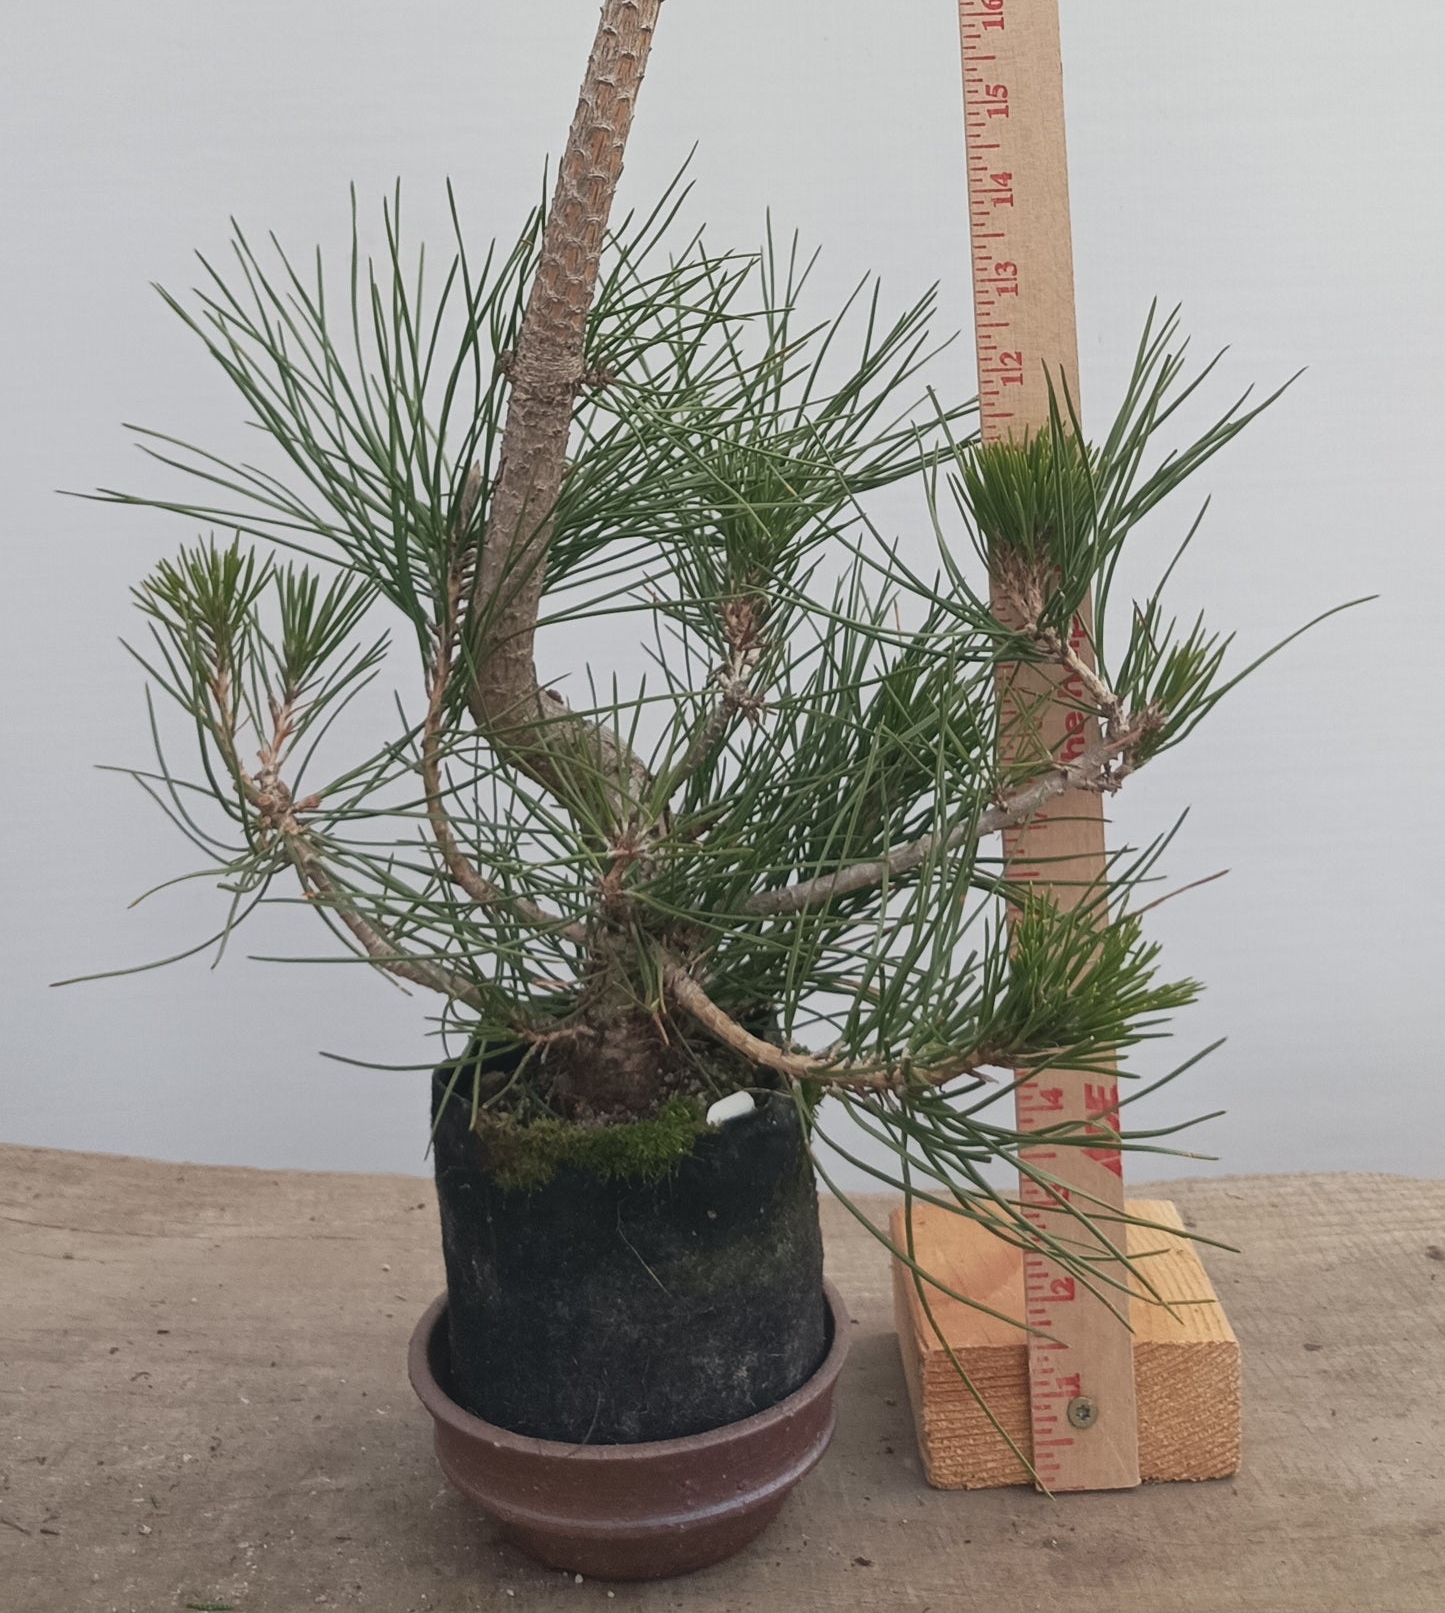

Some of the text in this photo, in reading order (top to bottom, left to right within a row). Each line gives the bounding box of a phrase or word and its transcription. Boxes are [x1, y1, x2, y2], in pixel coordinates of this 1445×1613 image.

[984, 83, 1009, 118] 15
[990, 171, 1014, 207] 14
[994, 260, 1018, 297] 13
[999, 350, 1024, 386] 12
[1040, 1087, 1063, 1105] 4
[1050, 1276, 1076, 1297] 2
[1056, 1373, 1081, 1392] 1
